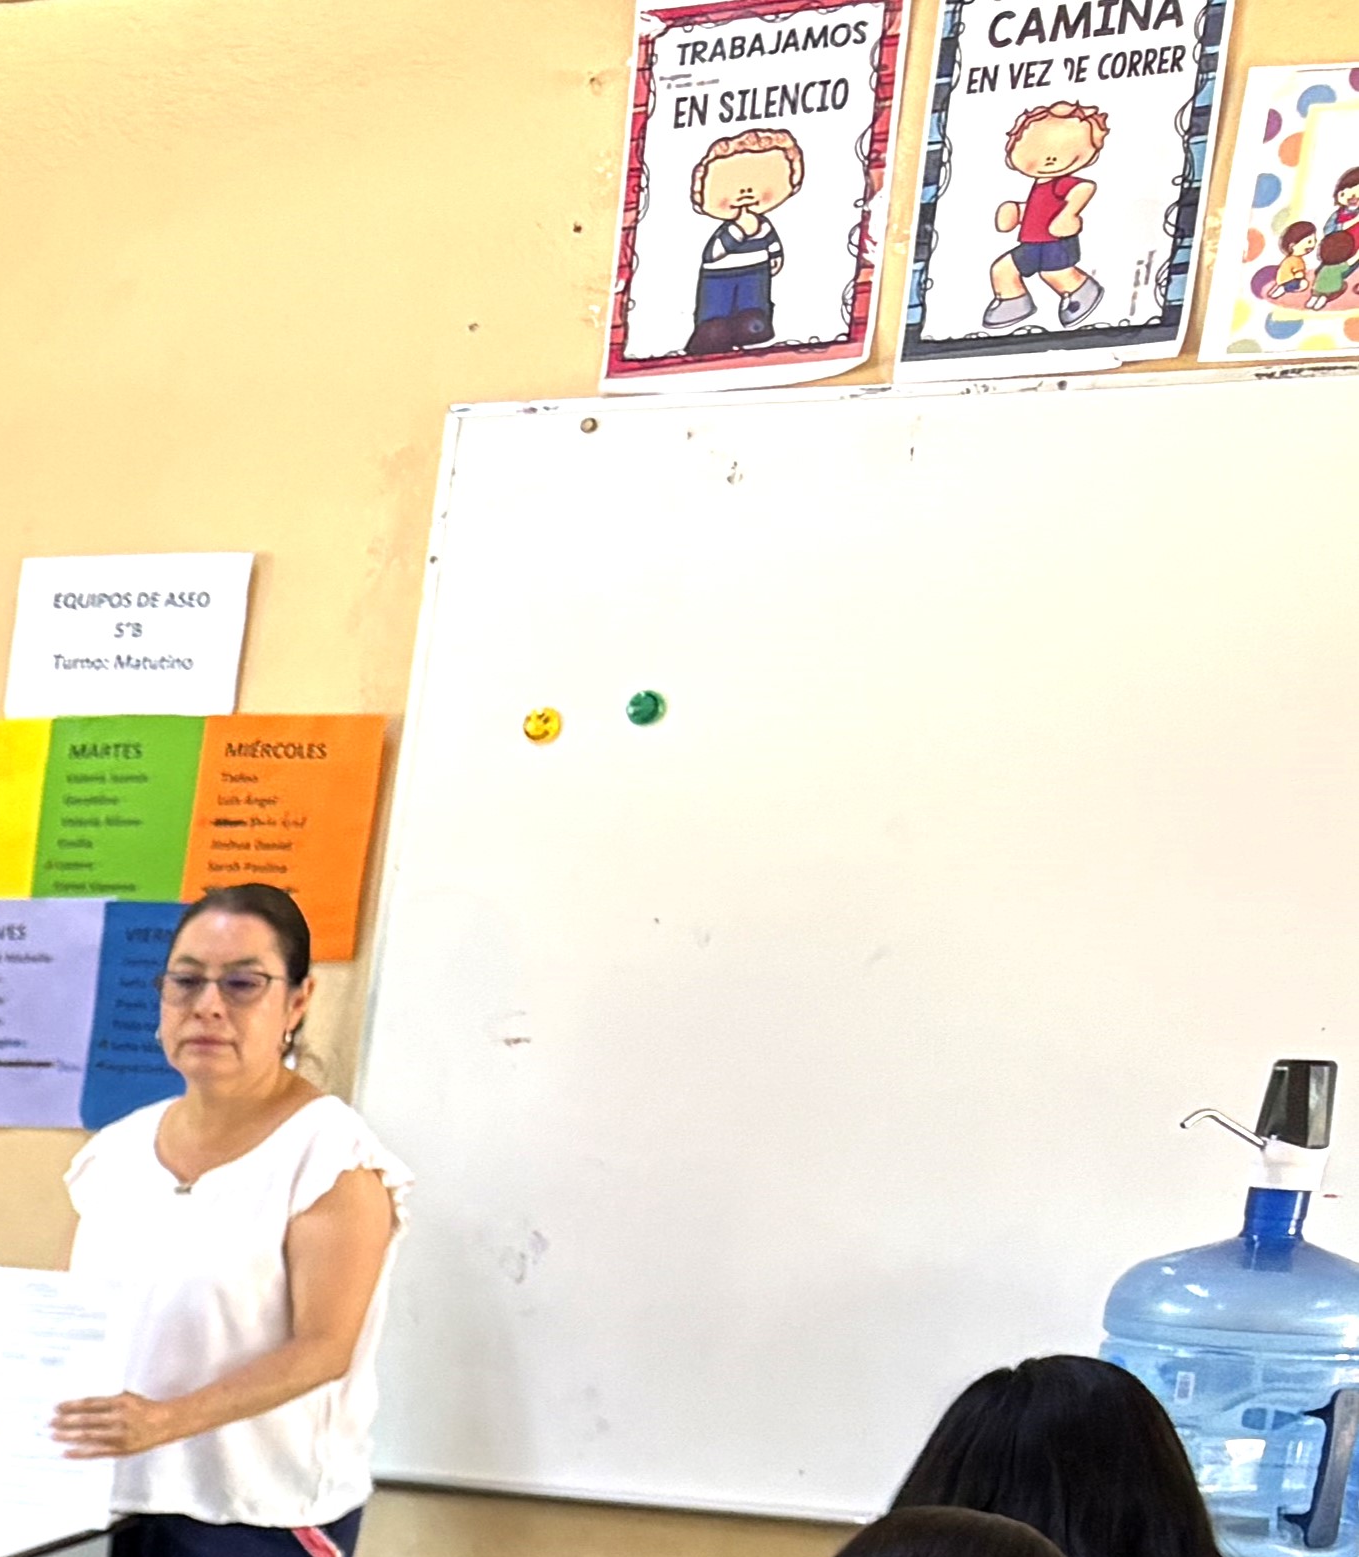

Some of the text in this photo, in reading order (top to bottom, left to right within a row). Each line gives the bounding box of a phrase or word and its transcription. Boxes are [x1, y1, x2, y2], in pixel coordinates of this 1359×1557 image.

[988, 0, 1184, 48] CAMINA
[676, 20, 869, 66] TRABAJAMOS
[966, 64, 1000, 94] EN
[1009, 58, 1054, 90] VEZ
[1097, 44, 1186, 80] CORRER
[673, 93, 709, 129] EN
[718, 77, 849, 123] SILENCIO
[53, 591, 211, 610] EQUIPOS DE ASEO
[53, 653, 194, 671] Turno: Matutino
[68, 742, 143, 760] MARTES
[224, 739, 328, 760] MIÉRCOLES
